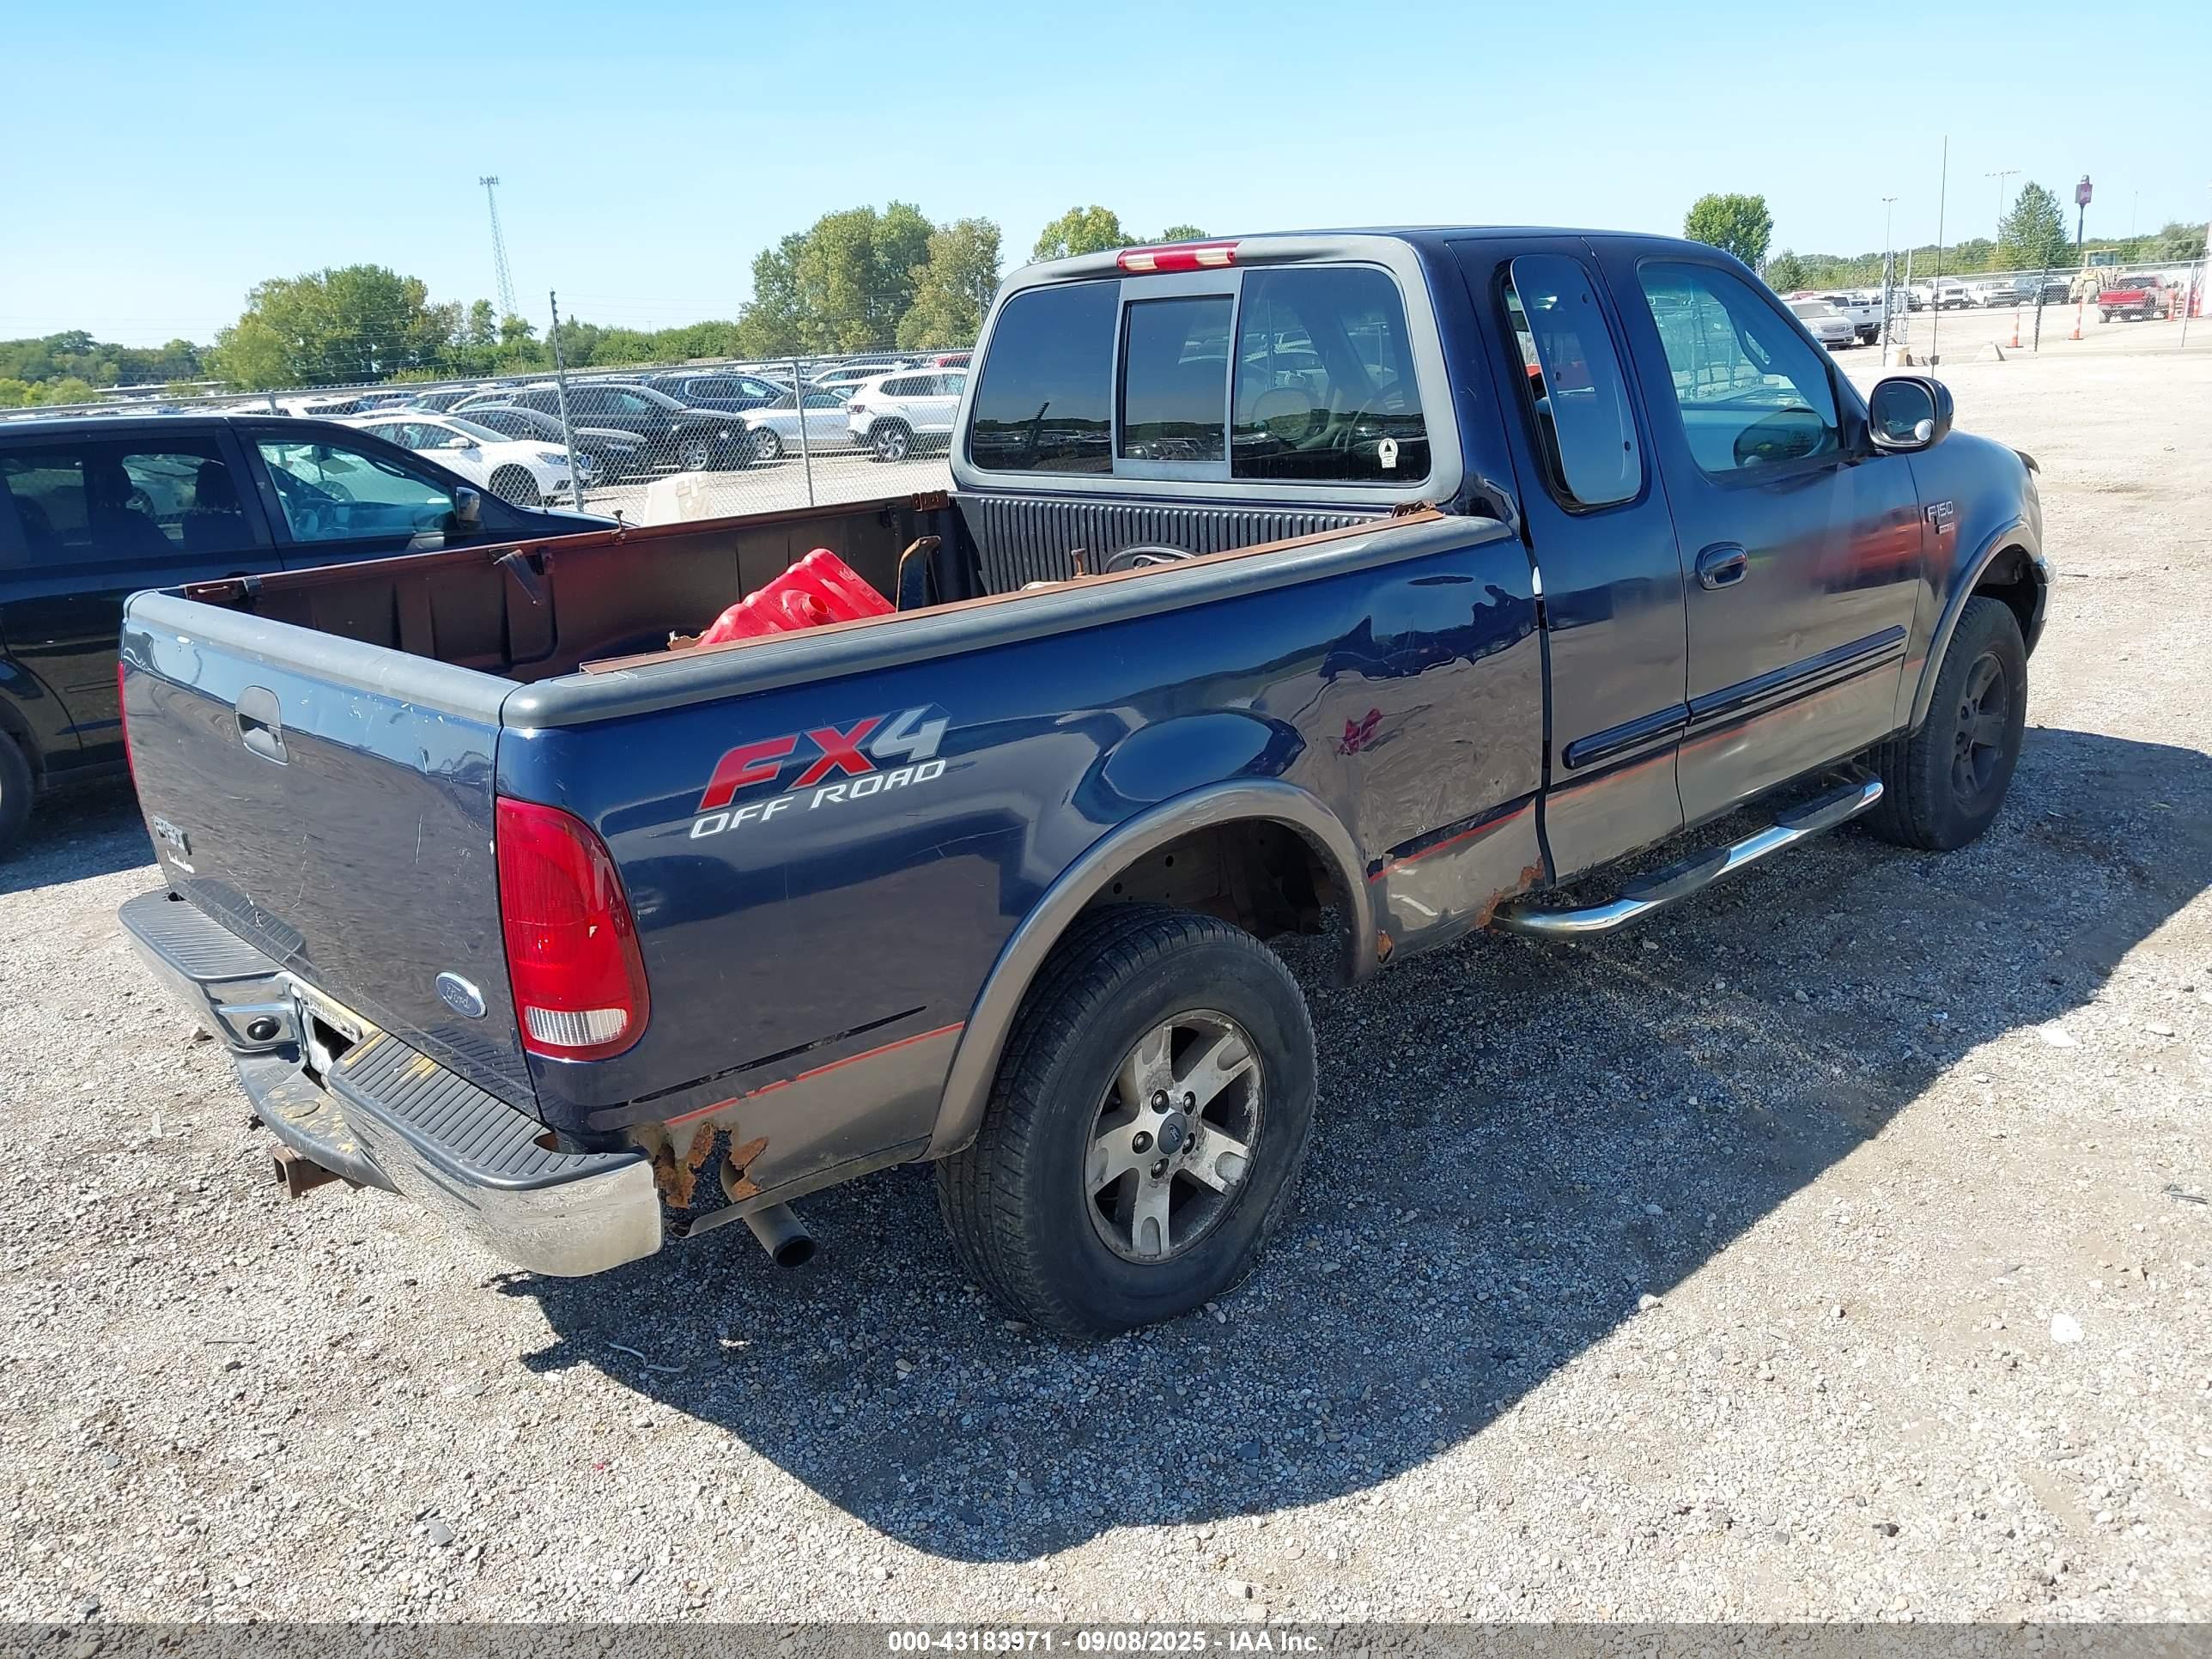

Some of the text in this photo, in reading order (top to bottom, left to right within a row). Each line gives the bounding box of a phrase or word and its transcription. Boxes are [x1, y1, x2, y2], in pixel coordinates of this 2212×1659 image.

[1926, 501, 1954, 522] F150
[690, 760, 947, 839] OFF ROAD
[697, 708, 951, 813] FX4
